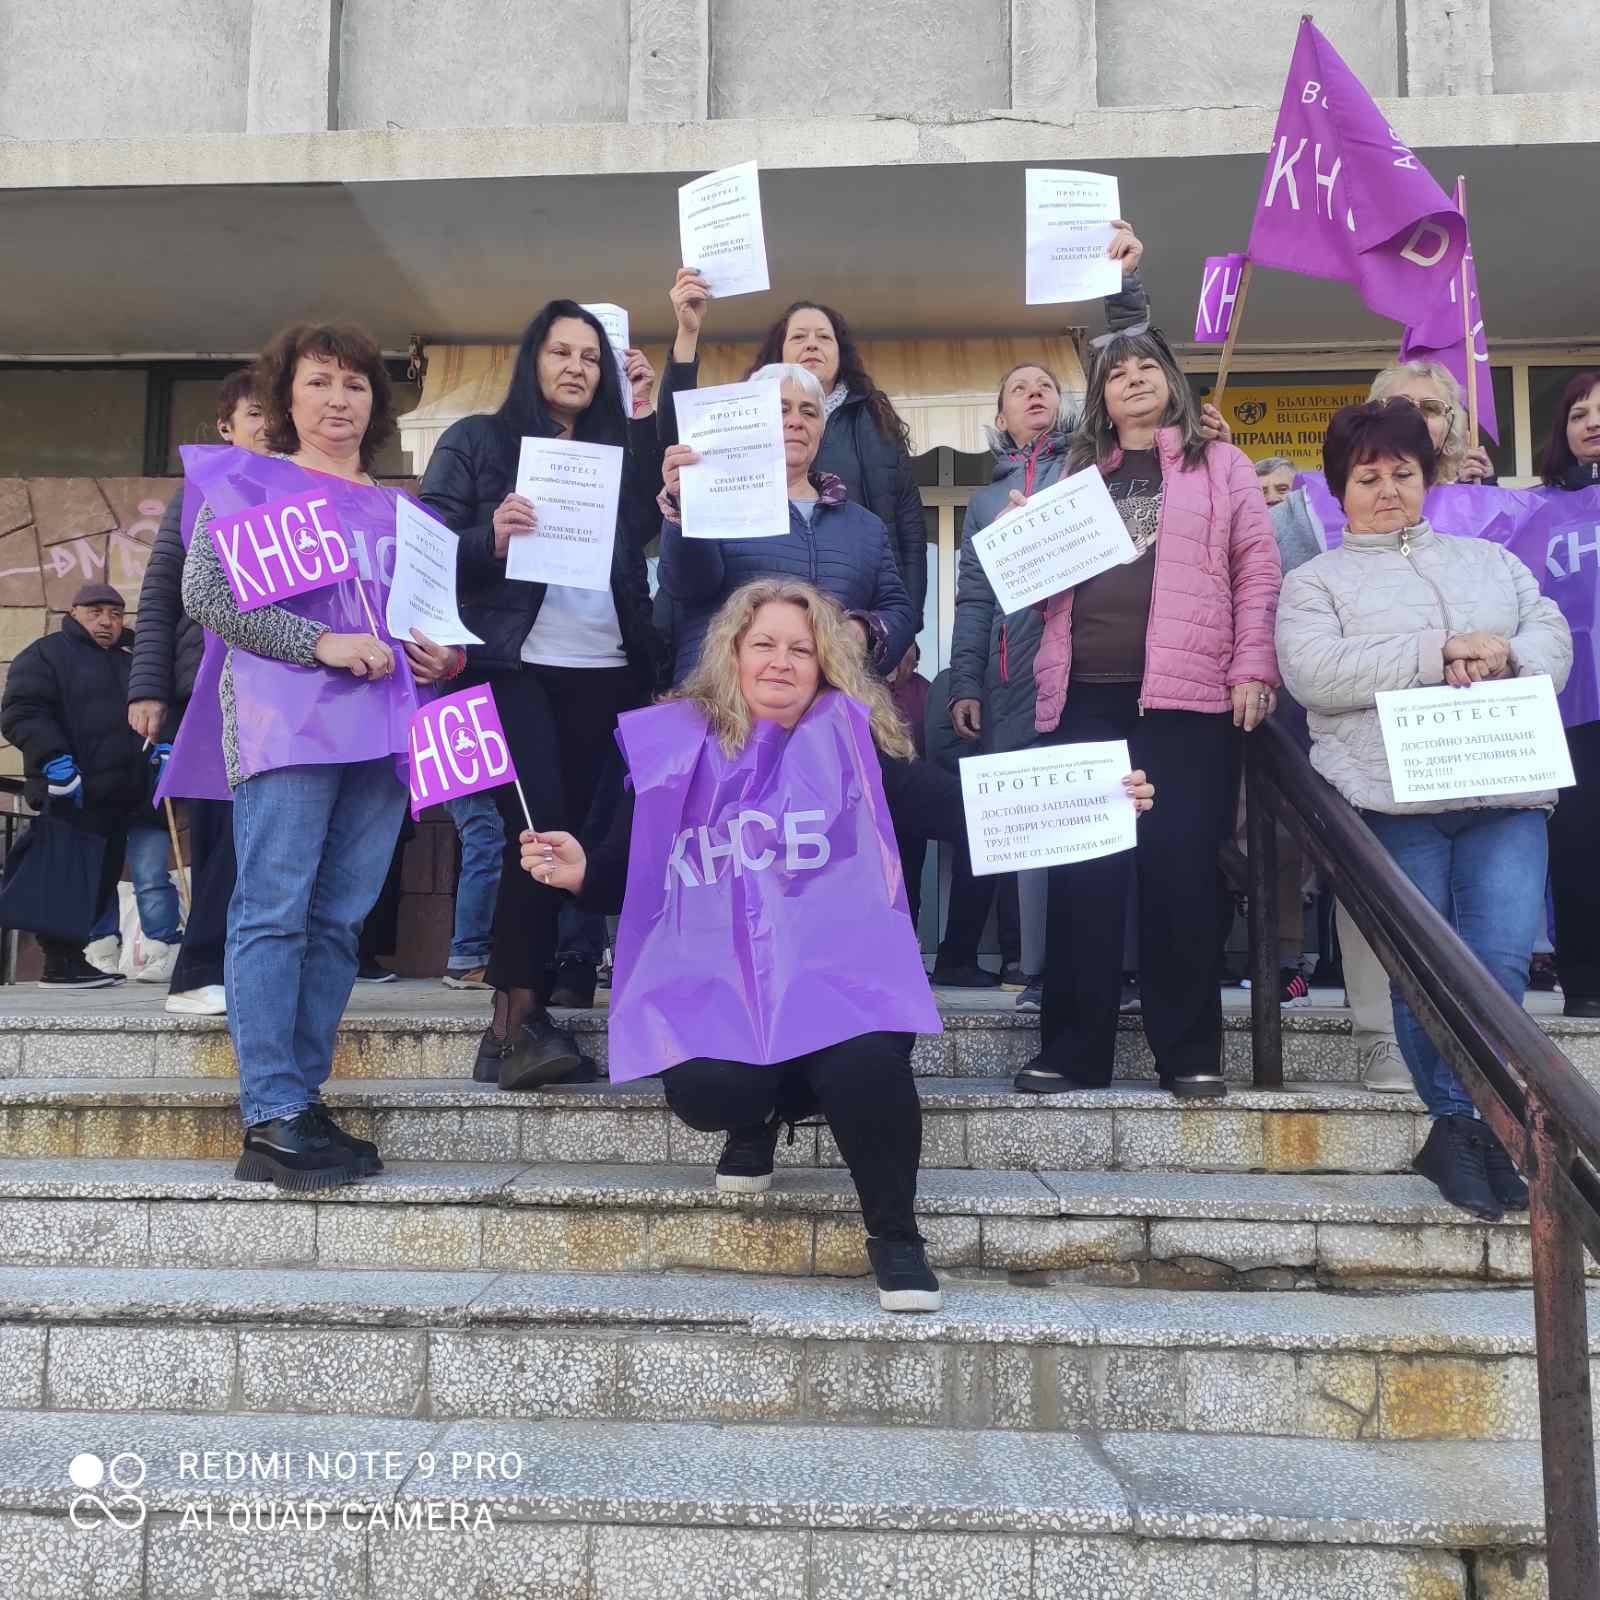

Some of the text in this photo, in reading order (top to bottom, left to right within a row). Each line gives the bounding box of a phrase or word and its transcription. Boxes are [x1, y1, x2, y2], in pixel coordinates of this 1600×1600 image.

[985, 497, 1078, 550] ПРОТЕСТ
[216, 498, 349, 602] КНСБ
[1396, 704, 1522, 728] ПРОТЕСТ
[409, 697, 509, 802] НСБ
[1399, 729, 1536, 752] ДОСТОЙНО ЗАПЛАЩАНЕ
[1424, 754, 1462, 766] ДОБРИ
[1464, 749, 1517, 762] УСЛОВИЯ
[1519, 747, 1537, 757] НА
[977, 769, 1095, 795] ПРОТЕСТ
[1407, 769, 1433, 779] ТРУД
[1407, 782, 1435, 792] СРАМ
[1436, 781, 1451, 789] МЕ
[1452, 779, 1467, 788] ОТ
[980, 795, 1109, 821] ДОСТОЙНО ЗАПЛАЩАНЕ
[1003, 821, 1038, 835] ДОБРИ
[1041, 814, 1091, 830] УСЛОВИЯ
[1094, 812, 1109, 822] НА
[664, 809, 831, 890] КНСБ
[984, 837, 1011, 849] ТРУД
[986, 852, 1012, 863] СРАМ
[1013, 849, 1029, 859] МЕ
[1029, 847, 1041, 857] ОТ
[1046, 840, 1098, 855] ЗАПЛАТАТА
